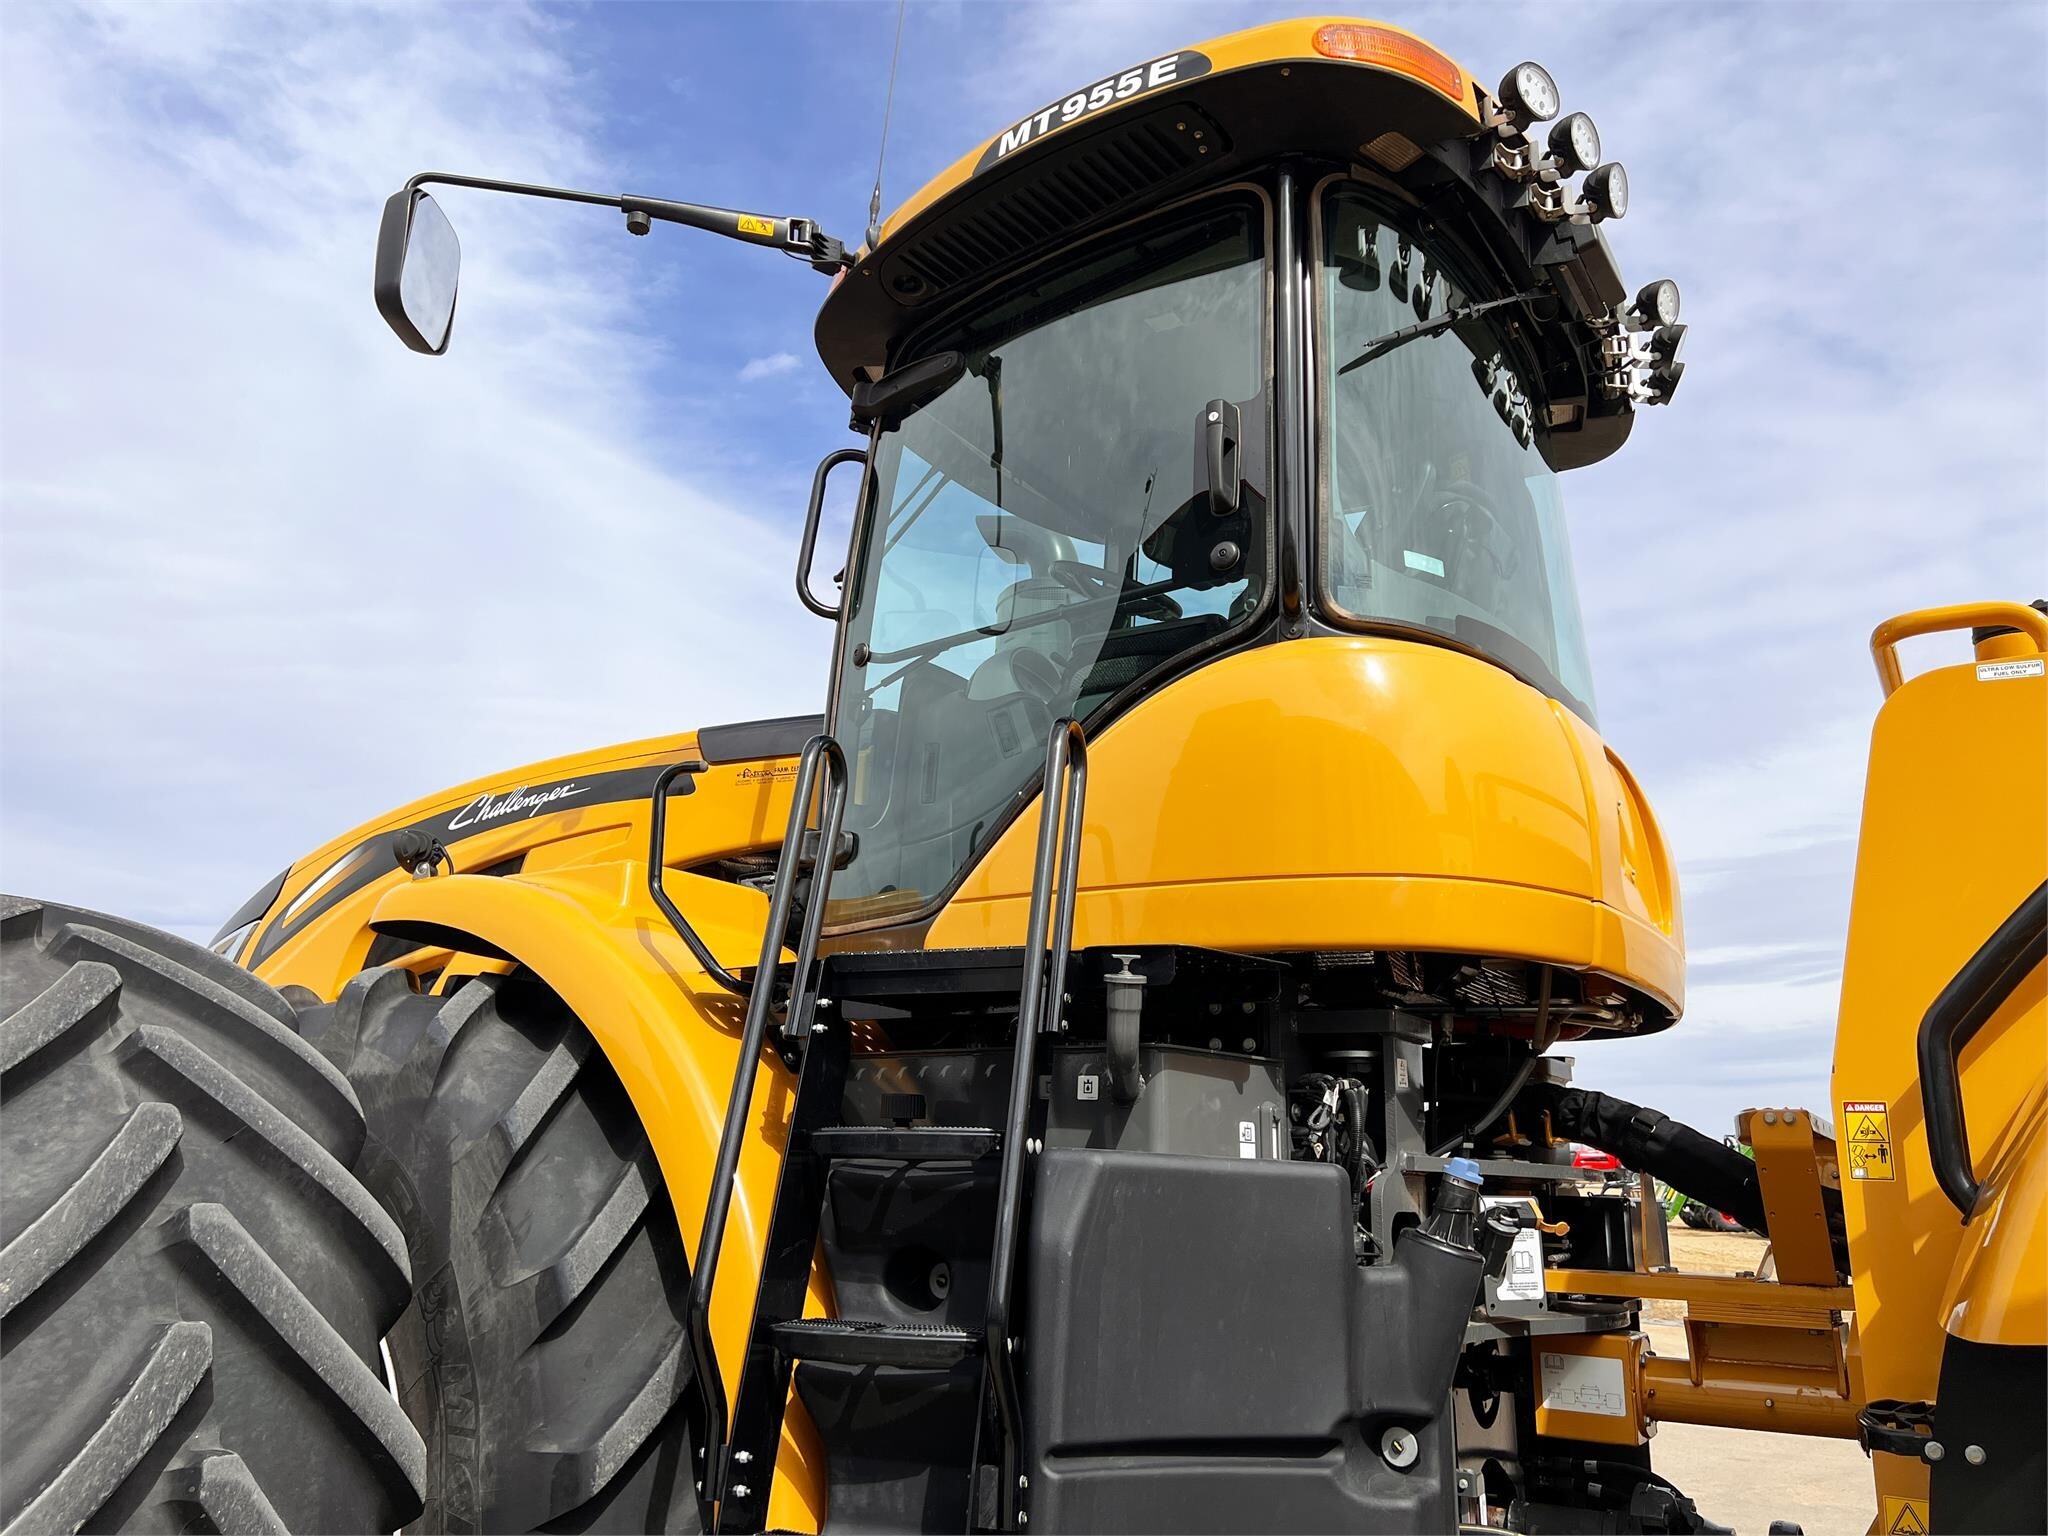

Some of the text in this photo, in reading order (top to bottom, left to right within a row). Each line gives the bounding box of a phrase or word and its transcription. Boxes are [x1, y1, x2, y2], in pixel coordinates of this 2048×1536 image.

[999, 56, 1179, 158] MT955E
[448, 784, 591, 831] Challenger
[1854, 1104, 1885, 1112] DANGER
